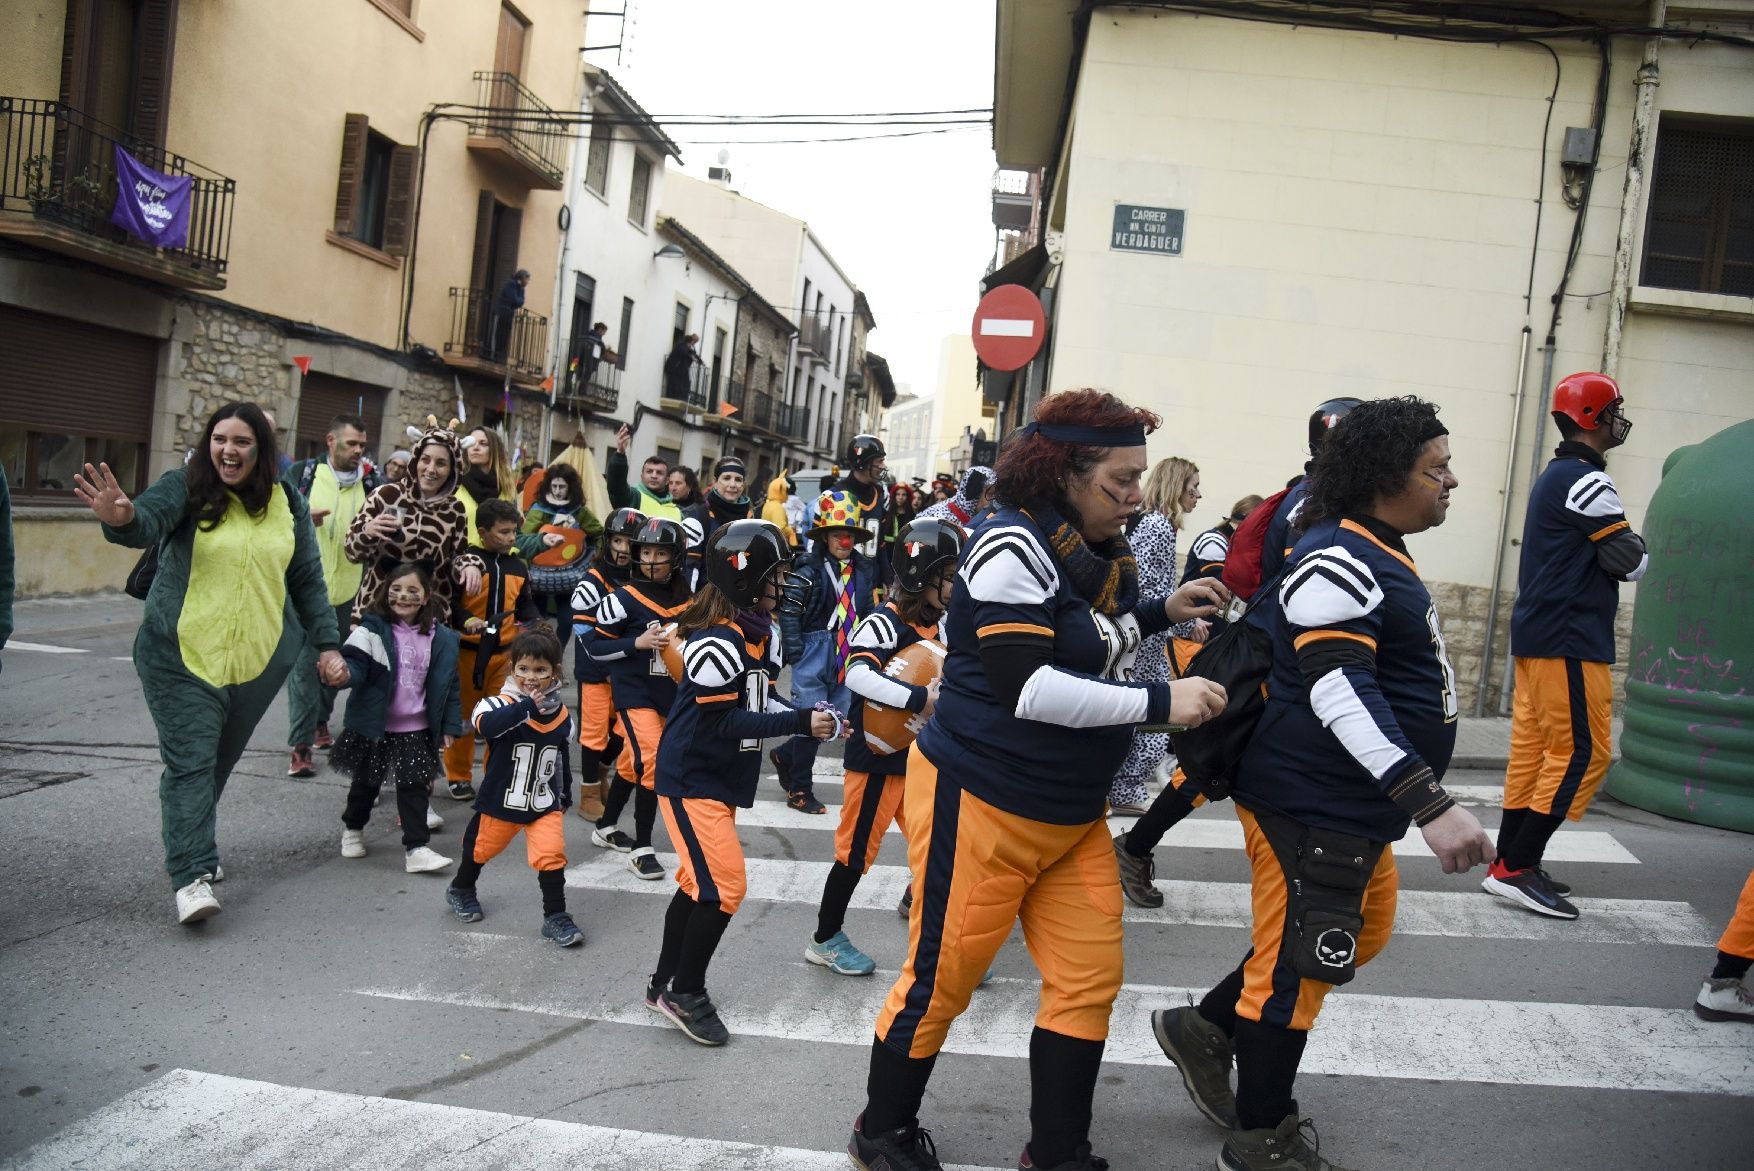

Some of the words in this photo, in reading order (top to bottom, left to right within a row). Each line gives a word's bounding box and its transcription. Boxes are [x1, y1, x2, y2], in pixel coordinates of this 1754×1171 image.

[1132, 209, 1166, 222] CARRER
[1116, 232, 1178, 250] VERDAGUER
[504, 742, 557, 812] 18
